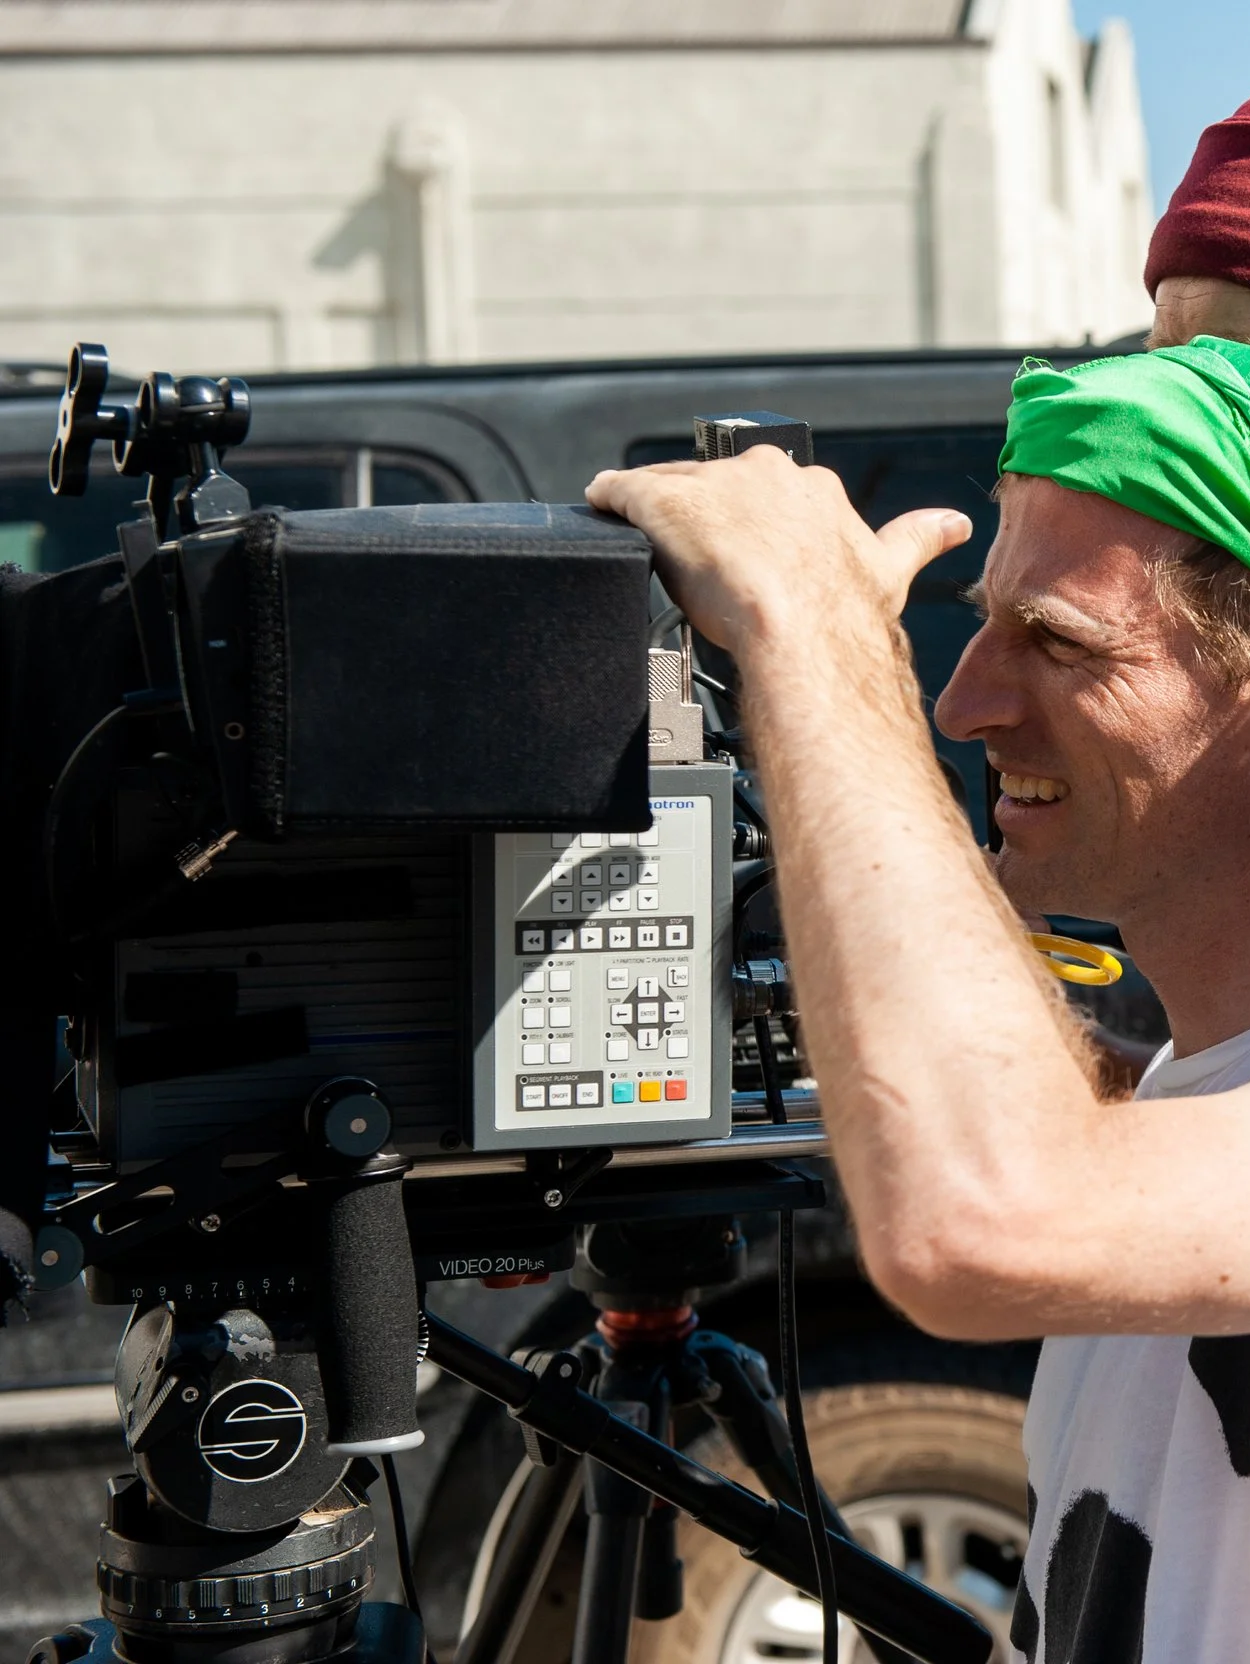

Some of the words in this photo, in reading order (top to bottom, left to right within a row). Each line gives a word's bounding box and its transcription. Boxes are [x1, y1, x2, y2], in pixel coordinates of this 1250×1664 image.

[439, 1258, 492, 1276] VIDEO
[495, 1257, 515, 1272] 20
[518, 1258, 545, 1271] Plus
[131, 1287, 143, 1298] 10
[158, 1286, 167, 1296] 9
[185, 1284, 193, 1294] 8
[211, 1282, 219, 1292] 7
[236, 1280, 245, 1290] 6
[262, 1278, 270, 1288] 5
[287, 1277, 295, 1286] 4
[127, 1604, 135, 1614] 7
[155, 1609, 163, 1618] 6
[188, 1609, 196, 1620] 5
[261, 1604, 269, 1614] 3
[296, 1597, 305, 1608] 2
[326, 1588, 333, 1599] 1
